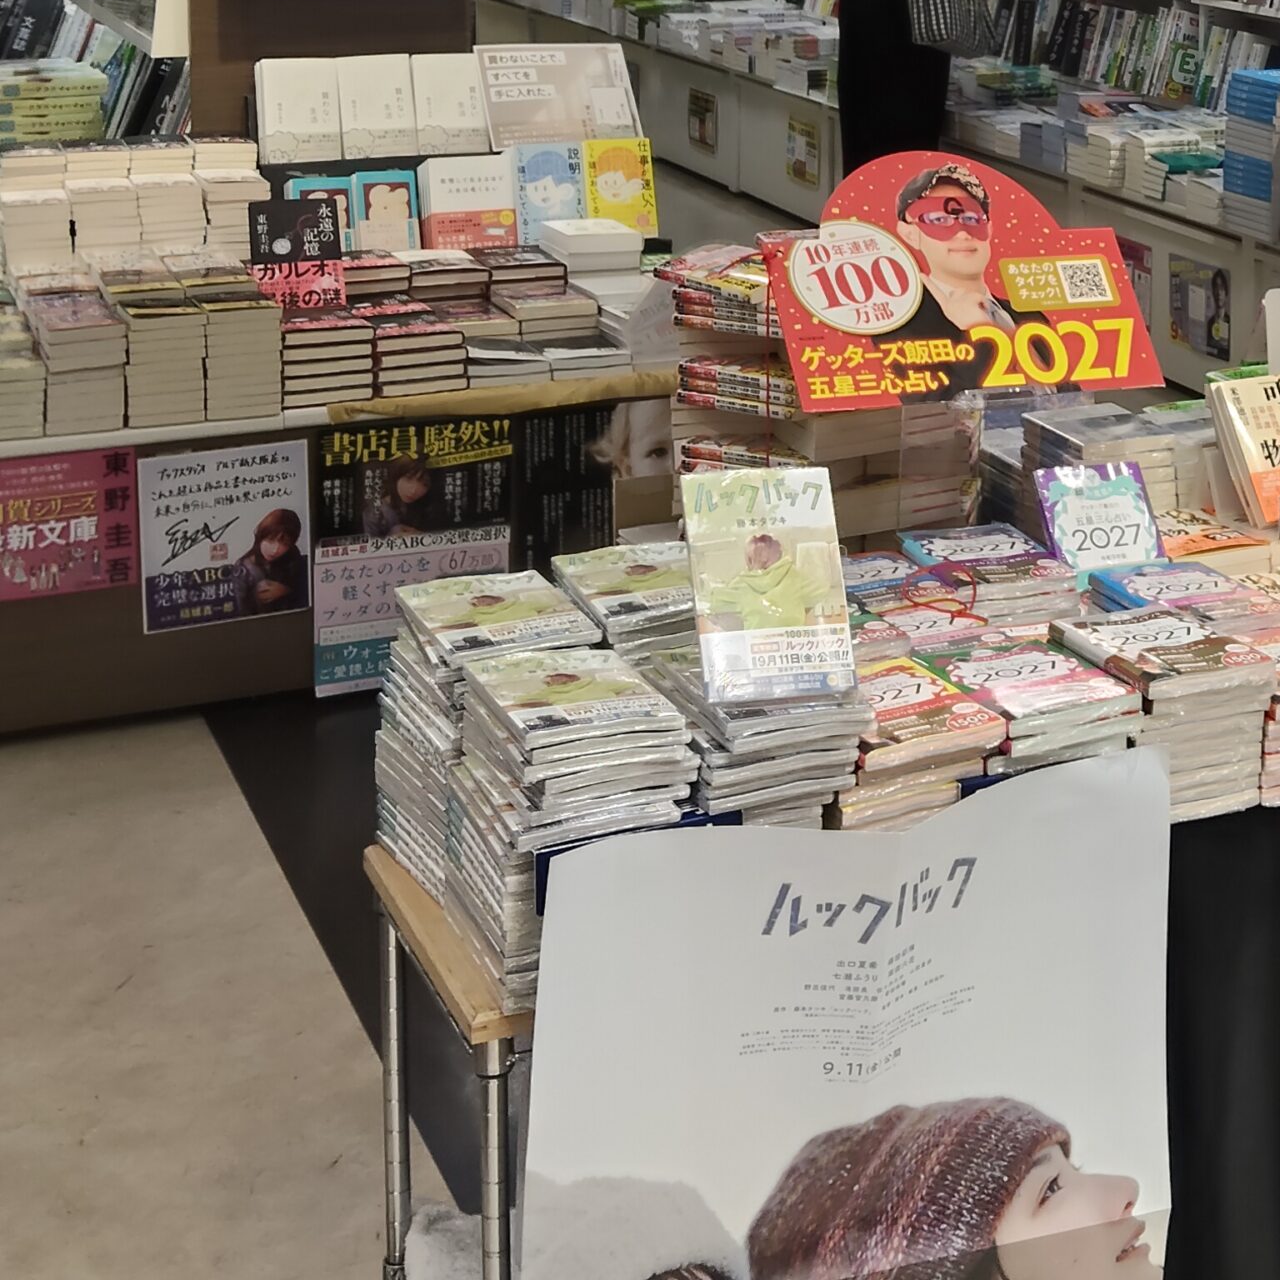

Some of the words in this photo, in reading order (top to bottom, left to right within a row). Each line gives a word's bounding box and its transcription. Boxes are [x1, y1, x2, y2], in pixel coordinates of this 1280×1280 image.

[488, 54, 562, 65] 買わないことで、
[492, 72, 531, 81] すべてを
[317, 204, 334, 241] 永遠の
[303, 228, 321, 256] 記憶
[804, 236, 881, 267] 10年連続
[1007, 263, 1054, 275] あなたの
[1015, 273, 1057, 286] タイプを
[810, 256, 909, 311] 100
[1019, 286, 1060, 300] チェック!
[853, 304, 894, 326] 万部
[801, 339, 975, 372] ゲッターズ飯田の
[970, 317, 1134, 388] 2027
[809, 371, 949, 400] 五星三心占い
[694, 478, 823, 515] ルックバック
[102, 451, 132, 583] 東野圭吾
[370, 525, 507, 553] 少年ABCの完璧な選択
[940, 540, 1019, 556] 2027
[1071, 523, 1142, 552] 2027
[156, 564, 246, 587] 少年ABCの
[320, 557, 431, 584] あなたの心を
[155, 583, 234, 607] 完璧な選択
[1146, 580, 1220, 596] 2027
[1111, 626, 1192, 647] 2027
[972, 659, 1057, 683] 2027
[950, 711, 989, 730] 1500
[761, 857, 978, 945] ルックバック
